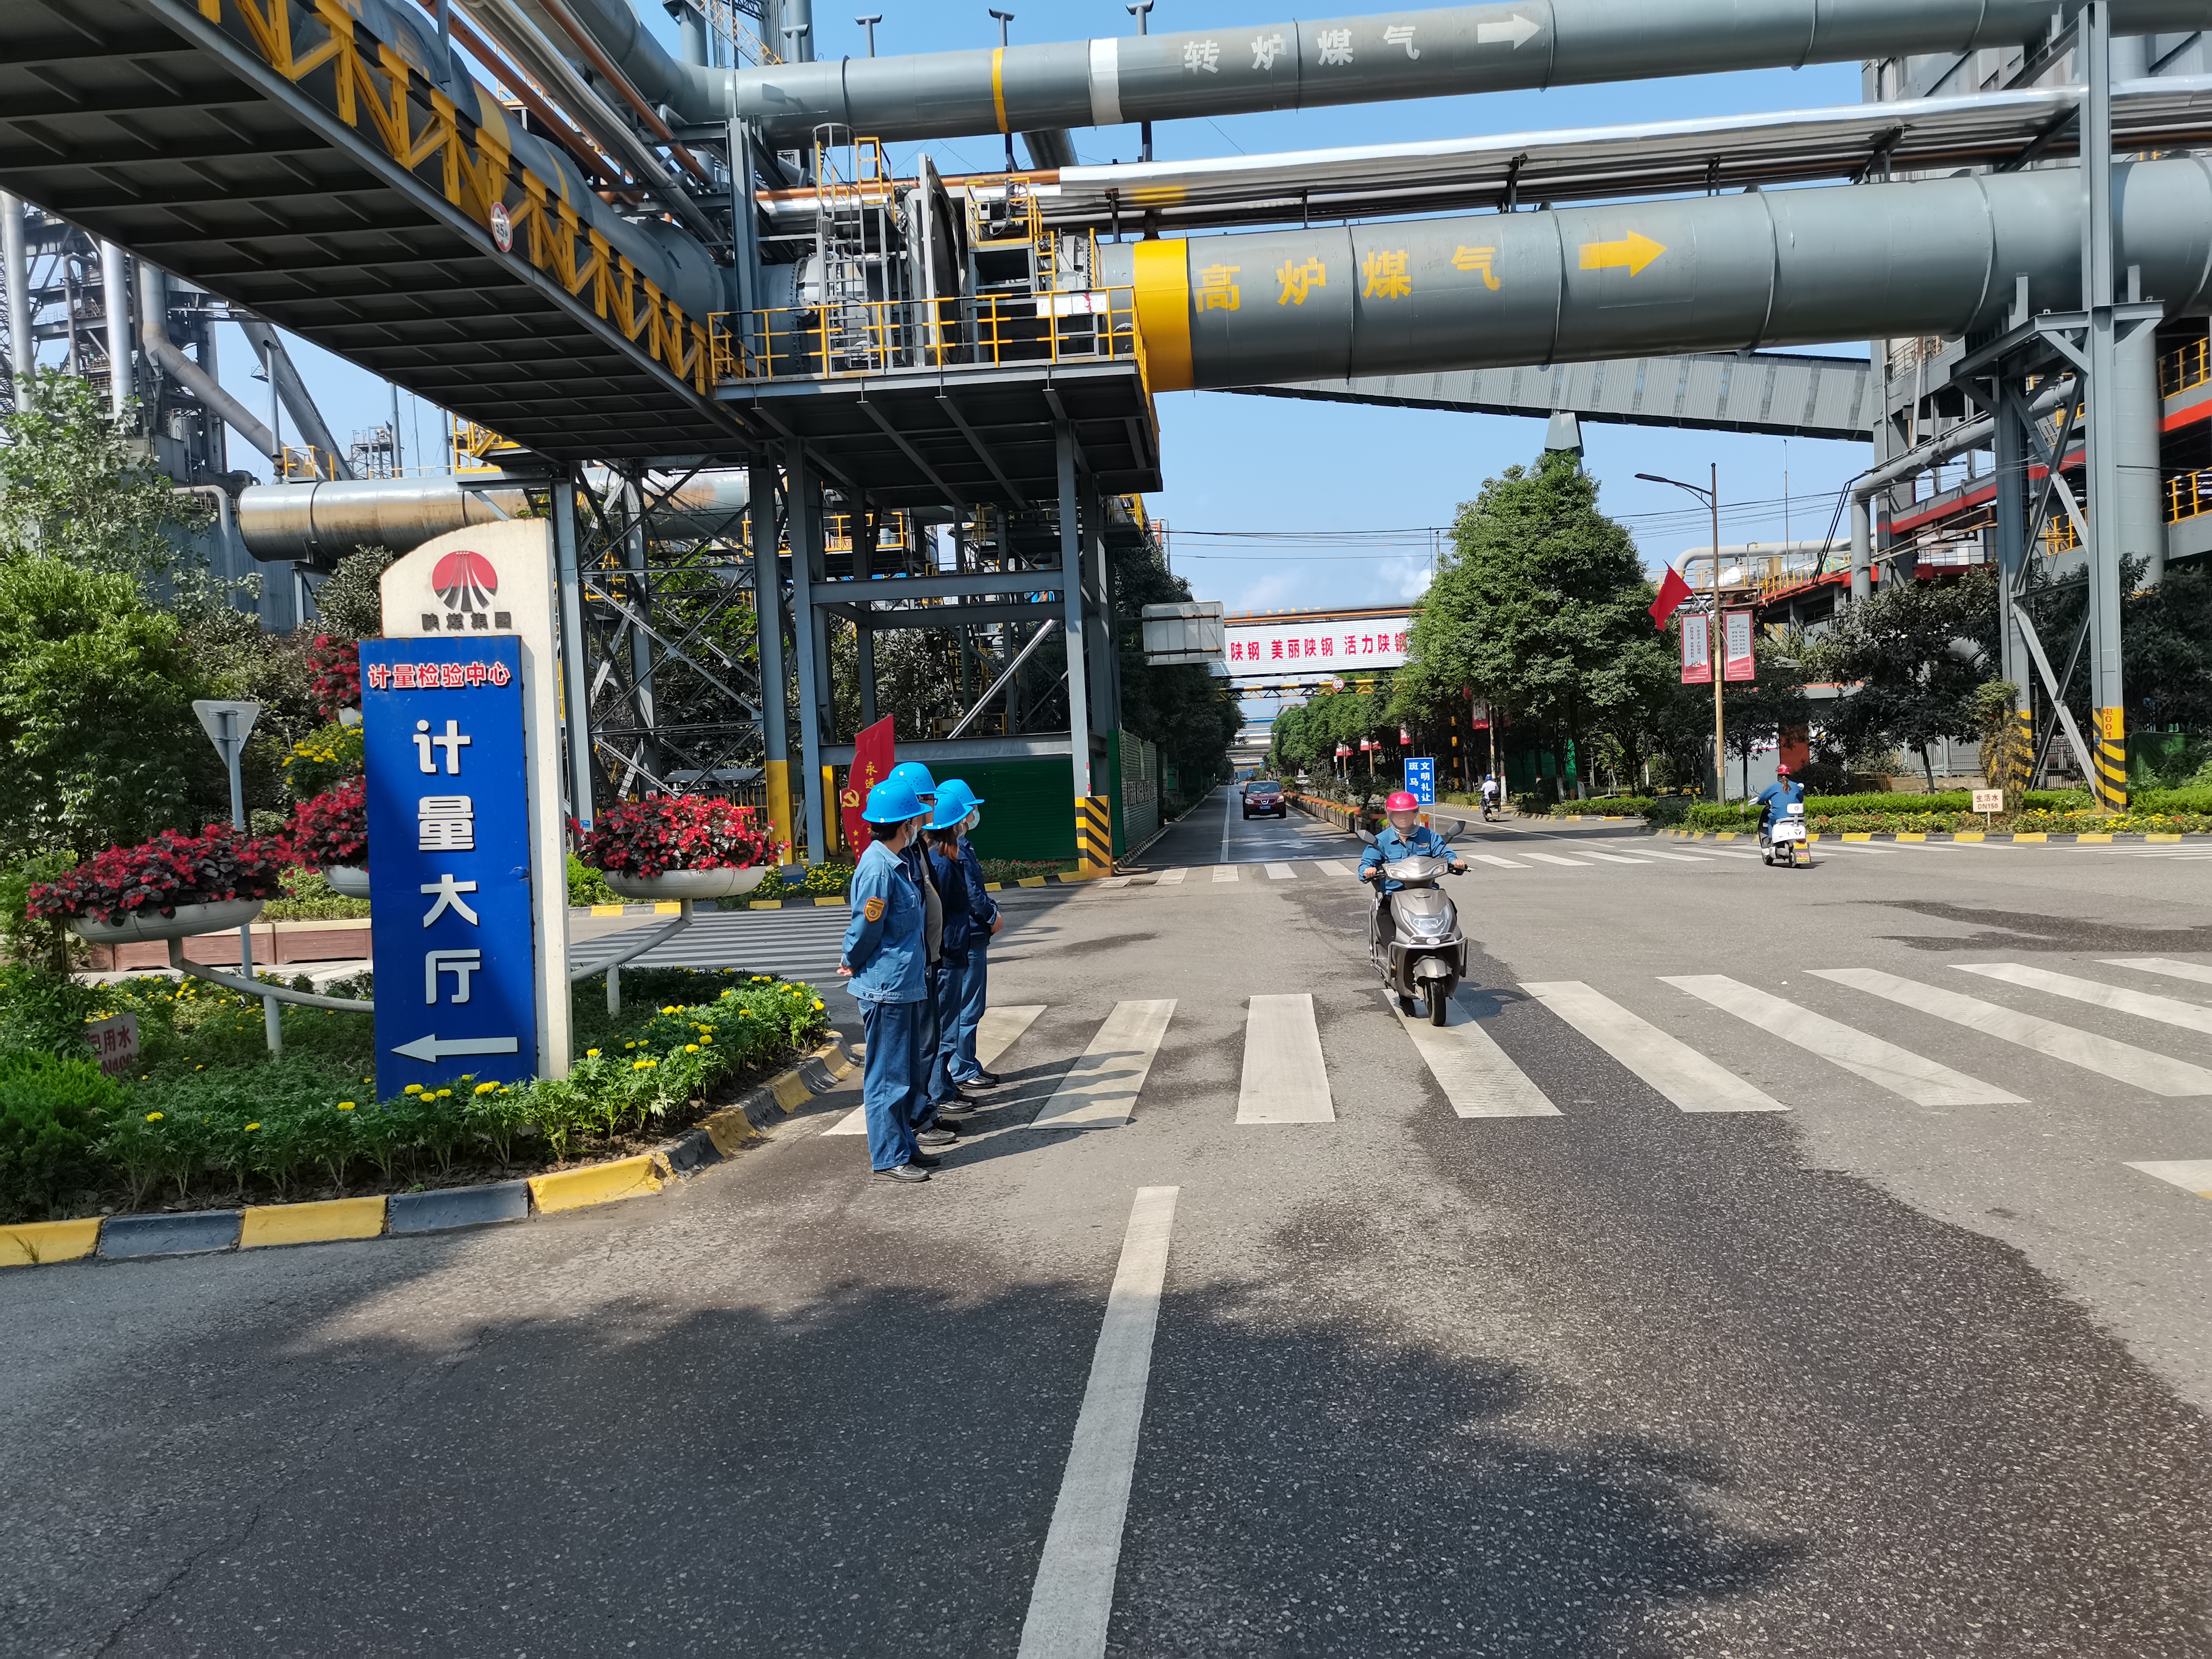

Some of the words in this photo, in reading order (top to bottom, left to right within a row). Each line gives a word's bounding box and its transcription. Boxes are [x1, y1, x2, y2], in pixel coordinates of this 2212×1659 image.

[1184, 26, 1420, 74] 转炉煤气
[1195, 245, 1501, 312] 高炉煤气
[1271, 637, 1334, 660] 美丽陕钢
[1344, 633, 1407, 655] 活力陕钢
[368, 661, 511, 689] 计量检验中心
[1420, 761, 1431, 802] 文明礼让
[1976, 793, 1998, 802] 生活水
[413, 719, 481, 1005] 计量大厅
